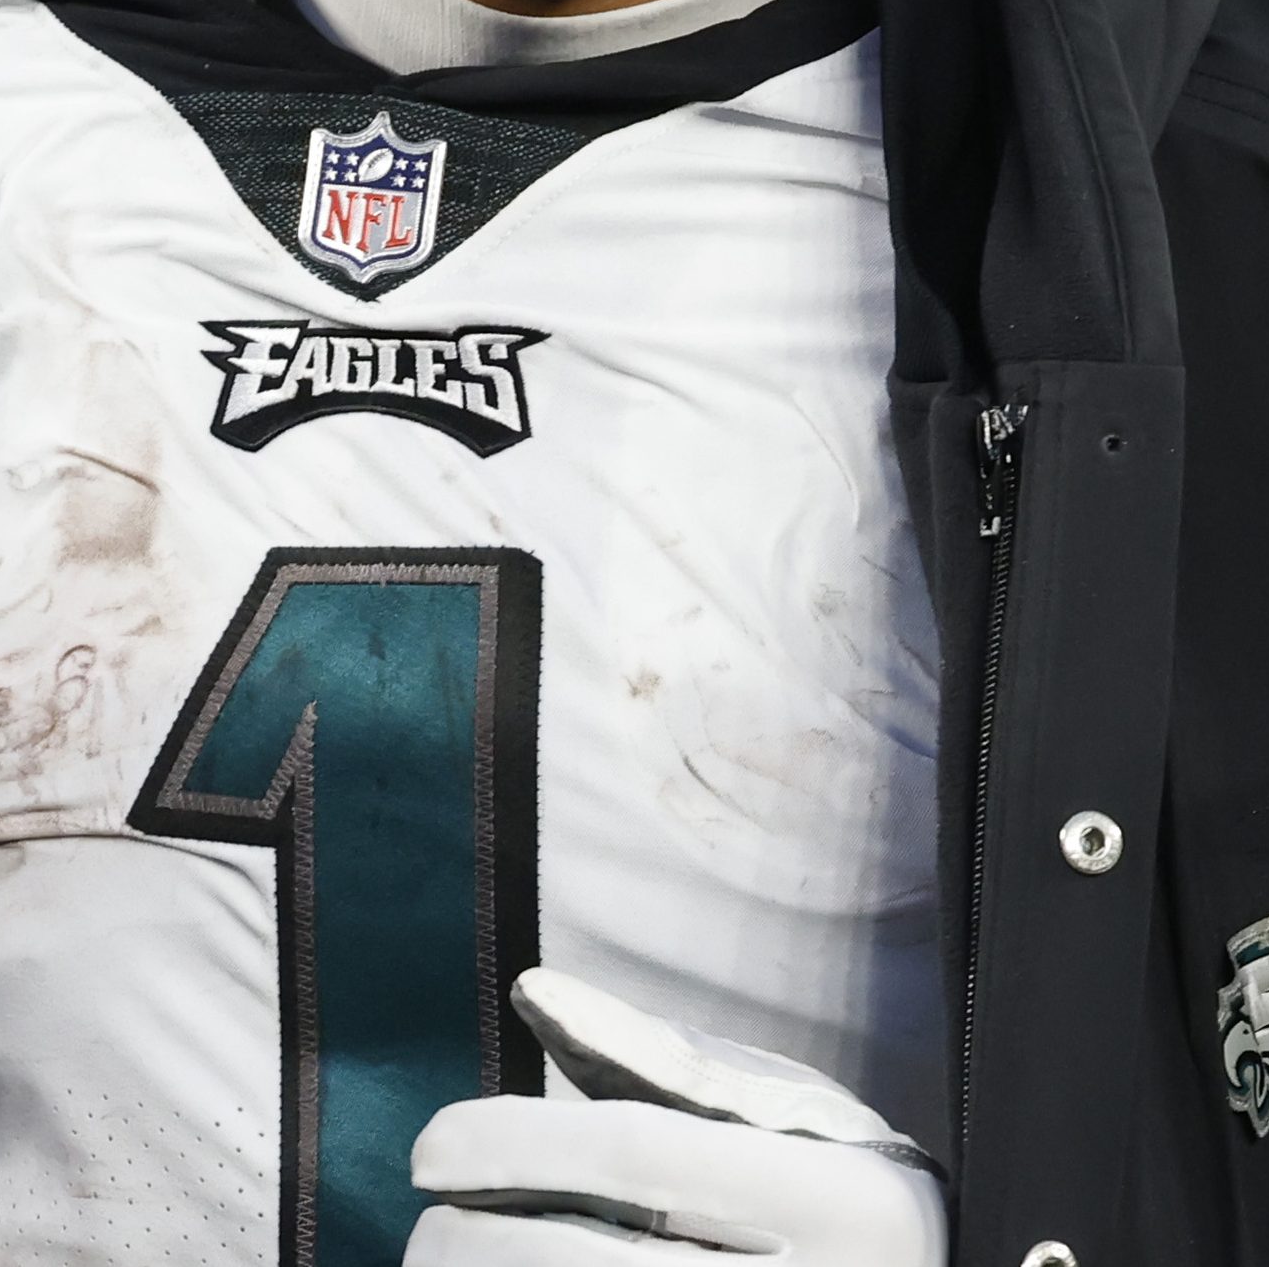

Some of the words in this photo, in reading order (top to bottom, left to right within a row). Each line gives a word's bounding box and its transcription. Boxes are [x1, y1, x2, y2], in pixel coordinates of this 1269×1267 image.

[322, 189, 413, 253] NFL
[220, 326, 526, 433] EAGLES
[127, 546, 546, 1267] 1
